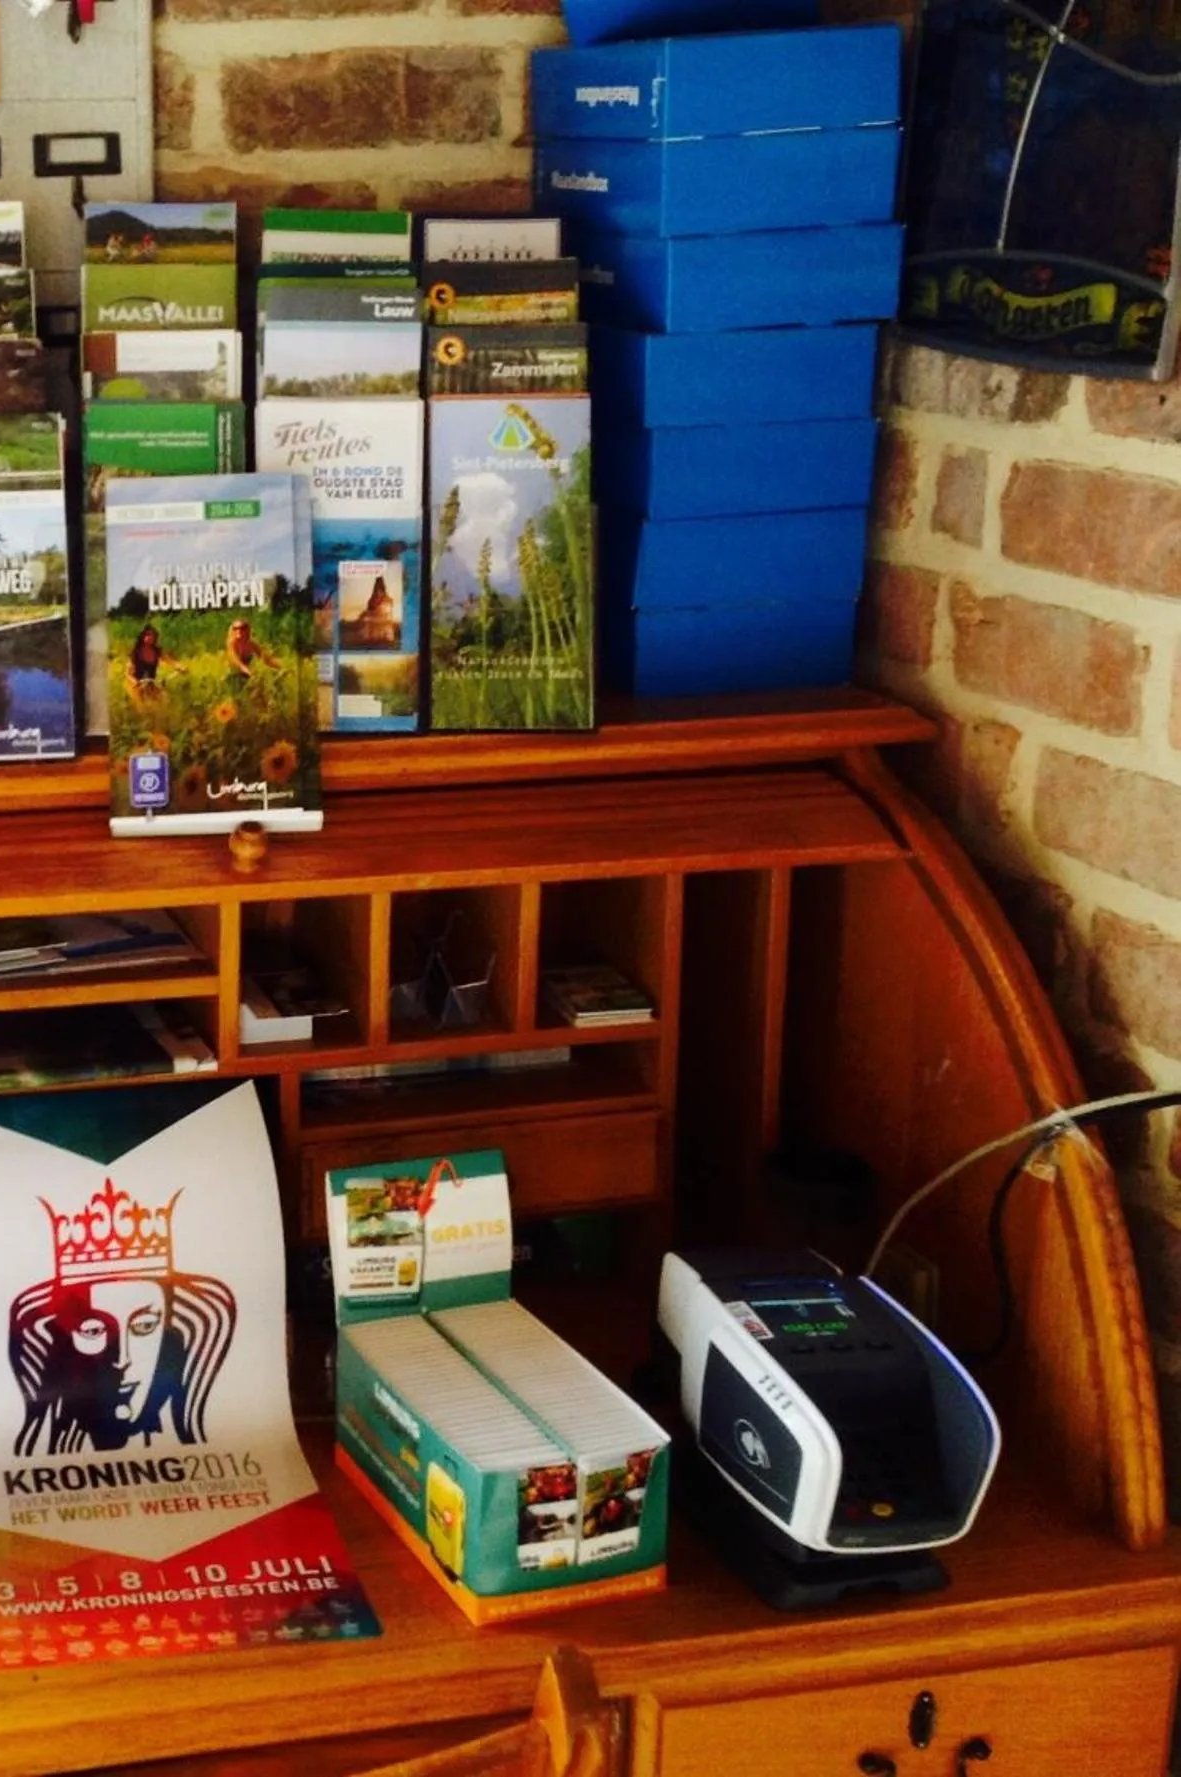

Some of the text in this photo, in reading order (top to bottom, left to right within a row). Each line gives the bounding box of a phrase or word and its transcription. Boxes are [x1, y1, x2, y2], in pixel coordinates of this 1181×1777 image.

[98, 301, 224, 325] MAASVALLEI
[374, 304, 415, 318] Lauw
[491, 360, 578, 377] Zammelen
[286, 435, 373, 467] routes
[313, 478, 404, 488] OUDSTE STAD
[326, 488, 353, 499] VAN
[148, 579, 266, 611] LOLTRAPPEN
[431, 1218, 505, 1243] GRATIS
[11, 1490, 272, 1525] HET WORDT WEER FEEST
[58, 1576, 79, 1596] 5
[120, 1571, 143, 1591] 8
[184, 1562, 227, 1584] 10
[243, 1555, 334, 1581] JULI
